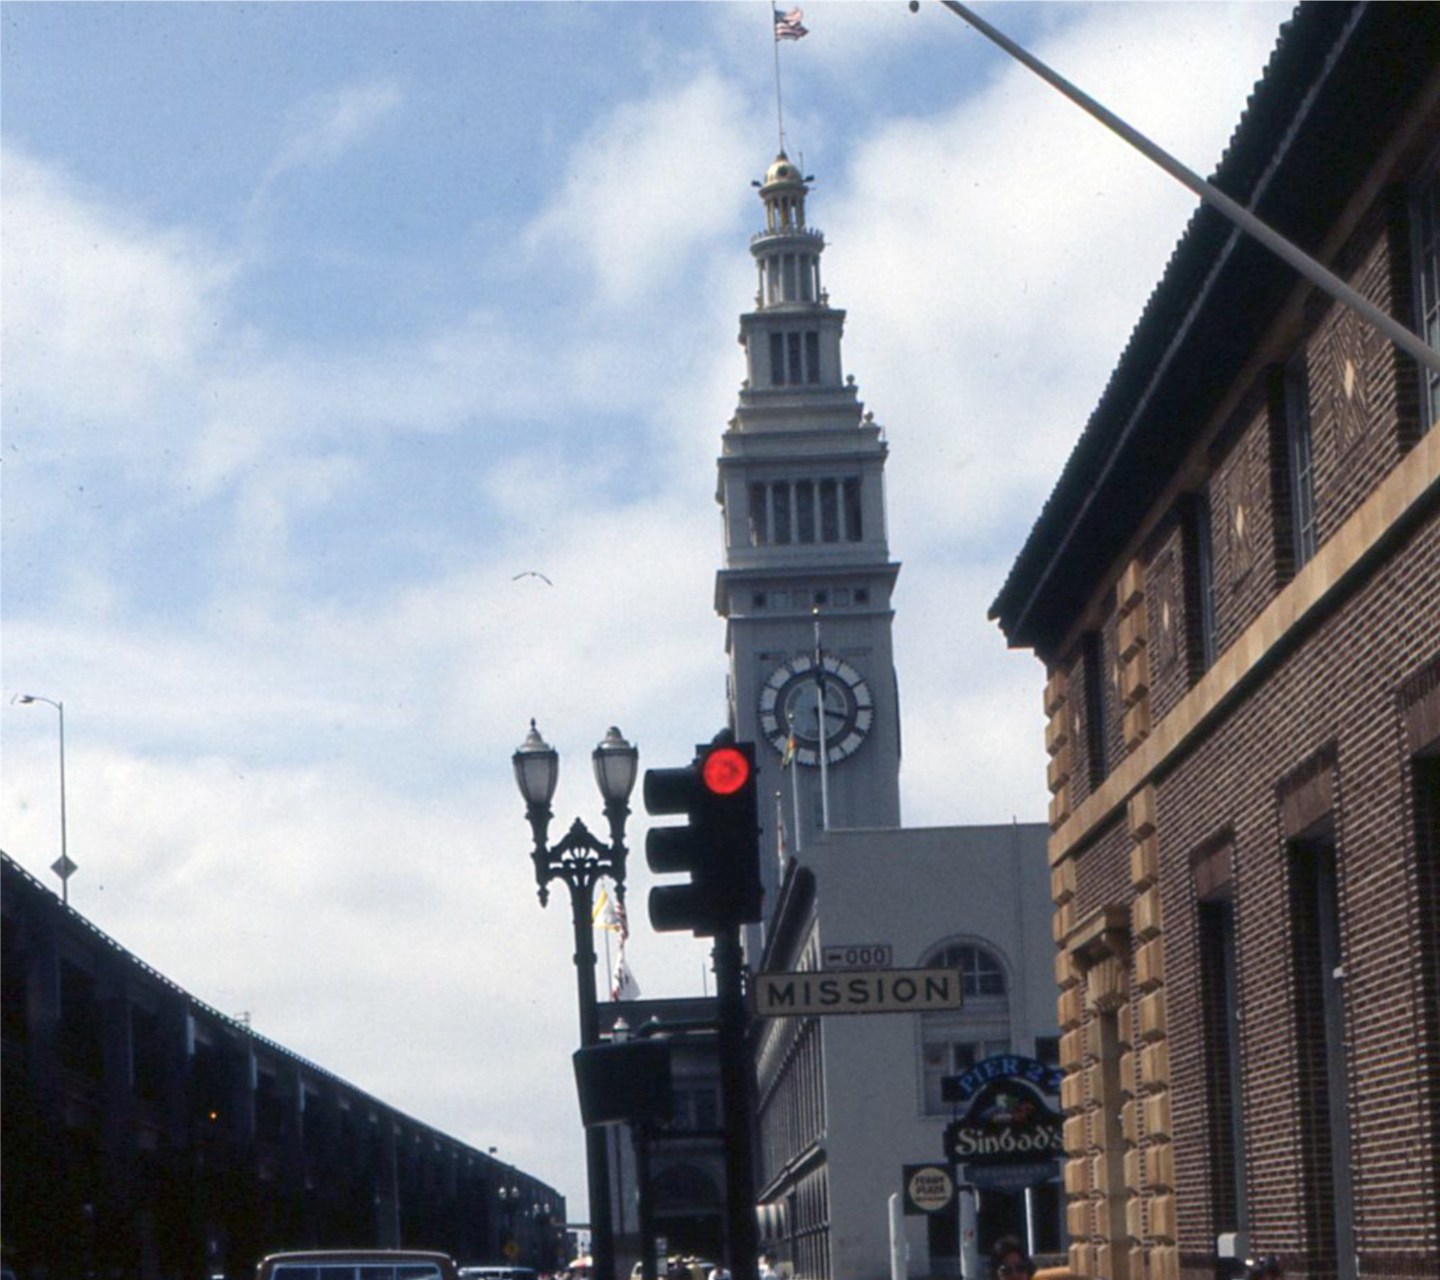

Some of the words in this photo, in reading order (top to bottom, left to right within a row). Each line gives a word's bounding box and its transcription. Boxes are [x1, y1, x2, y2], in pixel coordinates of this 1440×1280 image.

[767, 977, 949, 1008] MISSION
[959, 1058, 1018, 1094] PIER
[954, 1125, 1063, 1156] Sinbad's
